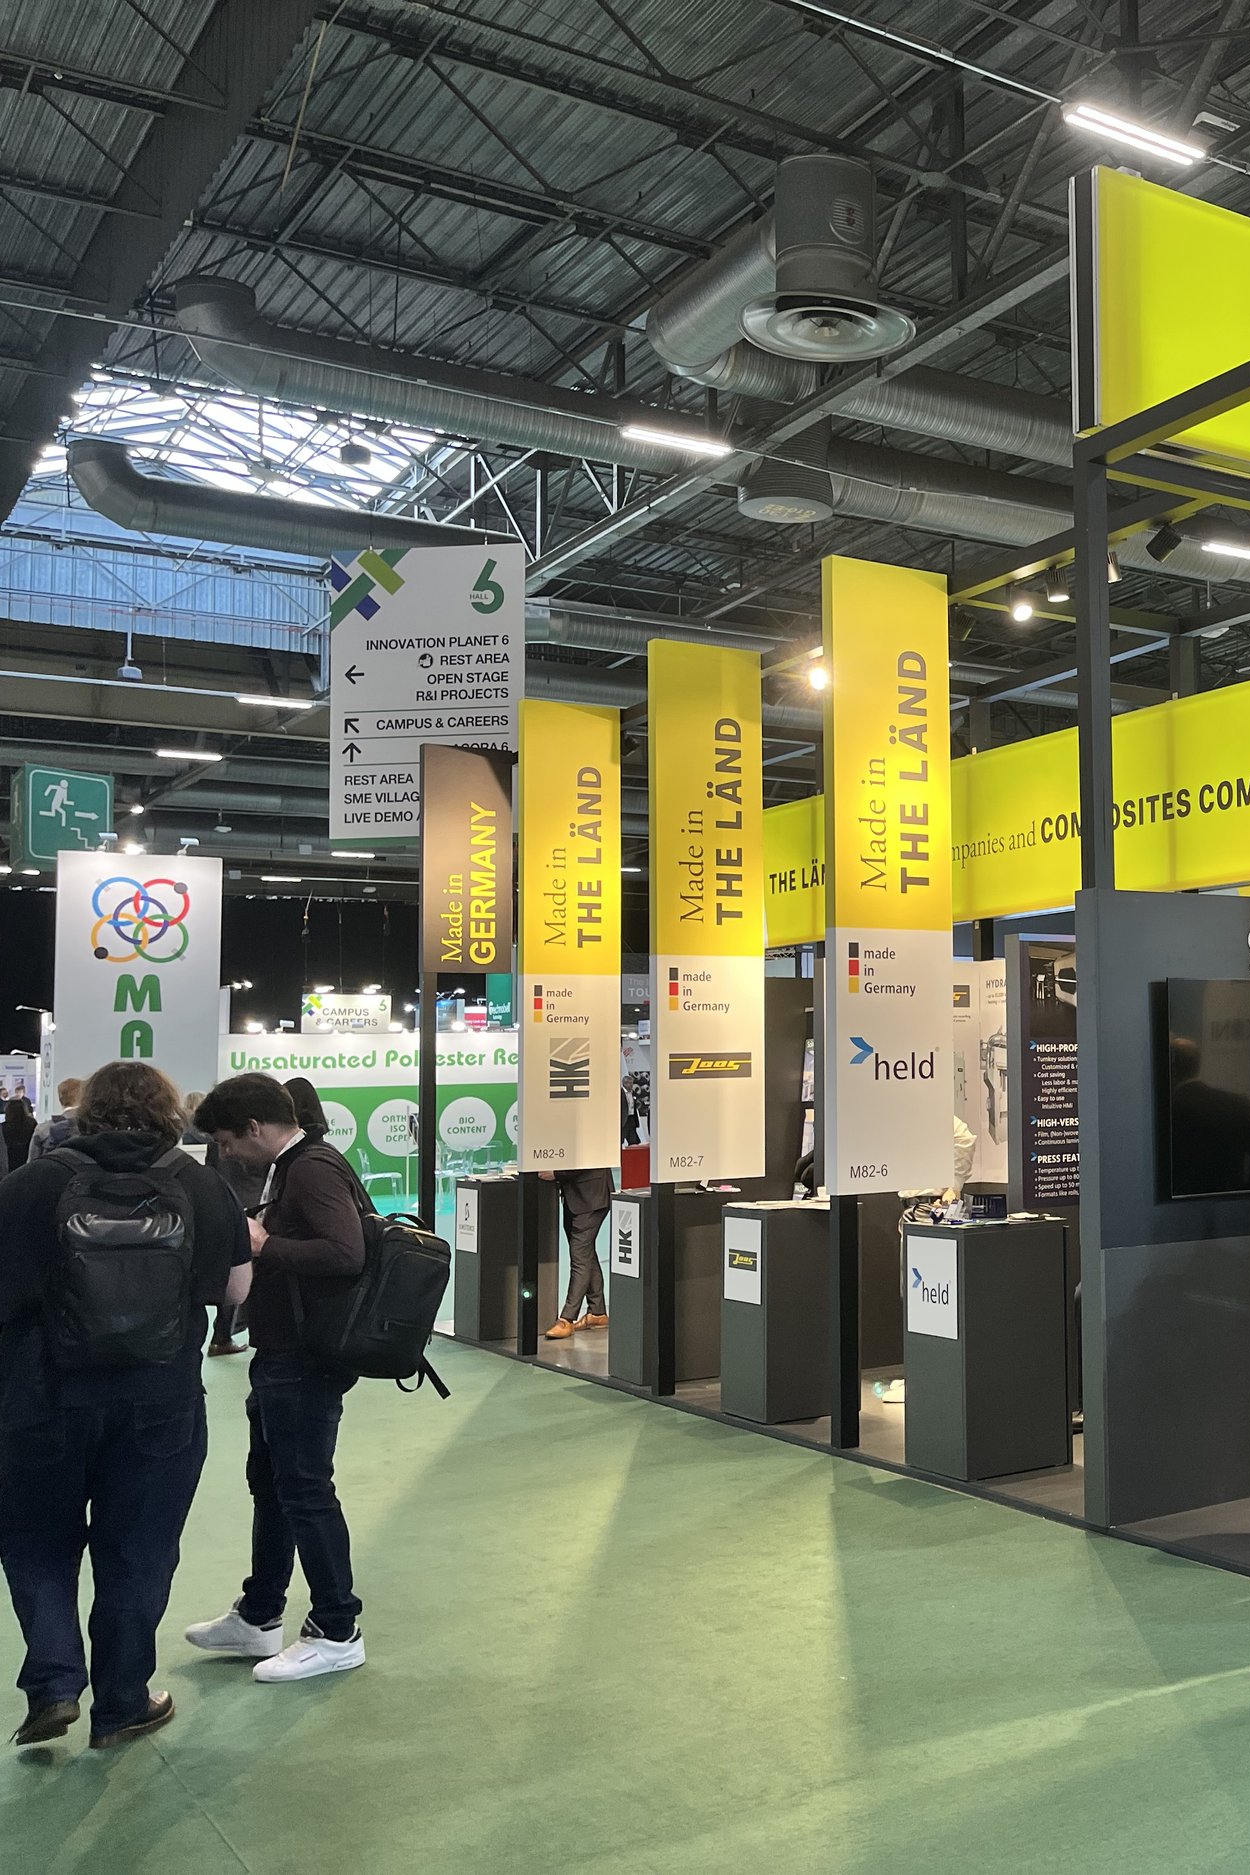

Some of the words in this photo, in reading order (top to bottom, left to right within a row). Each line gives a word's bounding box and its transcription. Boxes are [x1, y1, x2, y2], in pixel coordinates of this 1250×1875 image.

[471, 559, 505, 614] 6
[366, 638, 446, 650] INNOVATION
[449, 636, 499, 648] PLANET
[502, 635, 509, 646] 6
[440, 655, 473, 665] REST
[475, 653, 510, 664] AREA
[427, 674, 463, 684] OPEN
[467, 672, 509, 683] STAGE
[416, 691, 438, 701] R&I
[441, 688, 509, 701] PROJECTS
[376, 718, 432, 730] CAMPUS
[435, 718, 444, 728] &
[447, 715, 509, 728] CAREERS
[888, 651, 929, 781] LÄND
[501, 742, 509, 751] 6
[344, 775, 377, 786] REST
[380, 774, 414, 785] AREA
[706, 718, 742, 829] LÄND
[860, 757, 886, 790] in
[344, 794, 372, 804] SME
[375, 791, 420, 803] VILLAG
[344, 813, 371, 824] LIVE
[374, 811, 413, 823] DEMO
[569, 766, 602, 864] LÄND
[681, 809, 704, 836] in
[1009, 821, 1036, 850] and
[1041, 789, 1191, 844] COMOSITES
[858, 798, 887, 893] Made
[900, 803, 929, 895] THE
[546, 847, 566, 870] in
[443, 873, 463, 894] in
[470, 802, 496, 965] GERMANY
[679, 844, 704, 924] Made
[714, 847, 743, 926] THE
[770, 870, 796, 895] THE
[544, 878, 566, 948] Made
[577, 879, 602, 949] THE
[440, 901, 463, 963] Made
[864, 947, 896, 960] made
[682, 971, 711, 982] made
[864, 964, 875, 977] in
[546, 988, 573, 998] made
[682, 986, 692, 996] in
[864, 981, 916, 997] Germany
[322, 1008, 369, 1016] CAMPUS
[546, 1001, 555, 1010] in
[682, 999, 730, 1013] Germany
[546, 1013, 589, 1025] Germany
[230, 1051, 376, 1070] Unsaturated
[385, 1049, 488, 1069] Polester
[873, 1050, 935, 1081] held
[447, 1126, 486, 1134] CONTENT
[1037, 1118, 1079, 1127] HIGH-VERS
[533, 1148, 565, 1159] M82-8
[1038, 1155, 1061, 1163] PRESS
[670, 1155, 704, 1168] M82-7
[849, 1164, 888, 1179] M82-6
[922, 1281, 949, 1305] held
